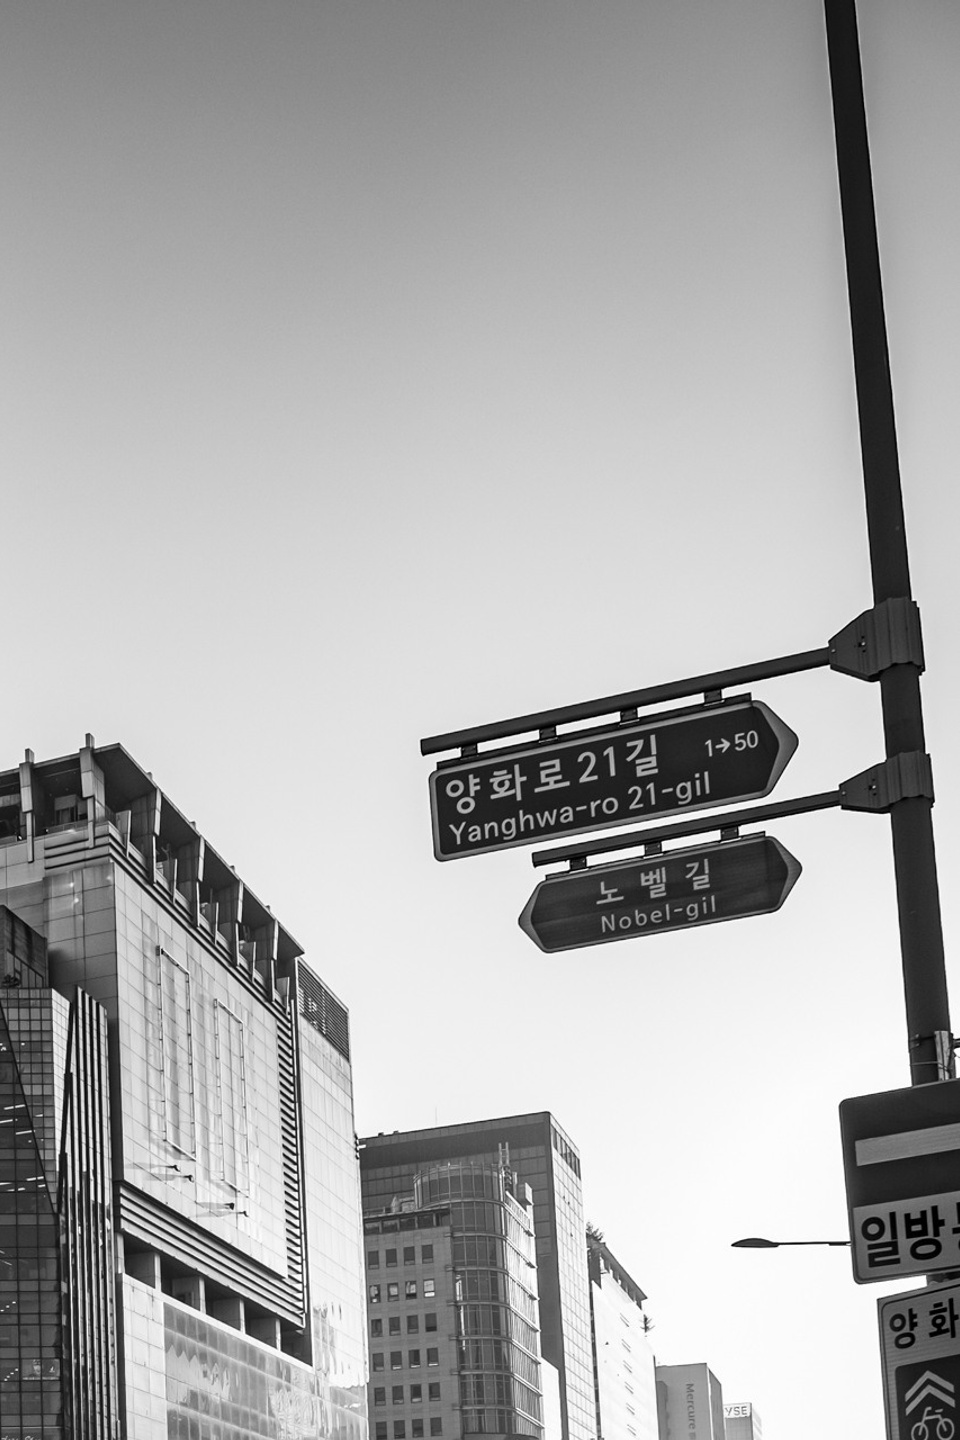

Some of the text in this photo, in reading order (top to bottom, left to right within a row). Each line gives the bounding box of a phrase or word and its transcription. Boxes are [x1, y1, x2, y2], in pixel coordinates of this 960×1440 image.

[445, 734, 659, 814] 양화로21길
[449, 771, 711, 845] Yanghwa-ro 21-gil
[600, 895, 716, 933] Nobel-gil
[889, 1298, 959, 1349] 양화
[685, 1383, 697, 1430] Mercure
